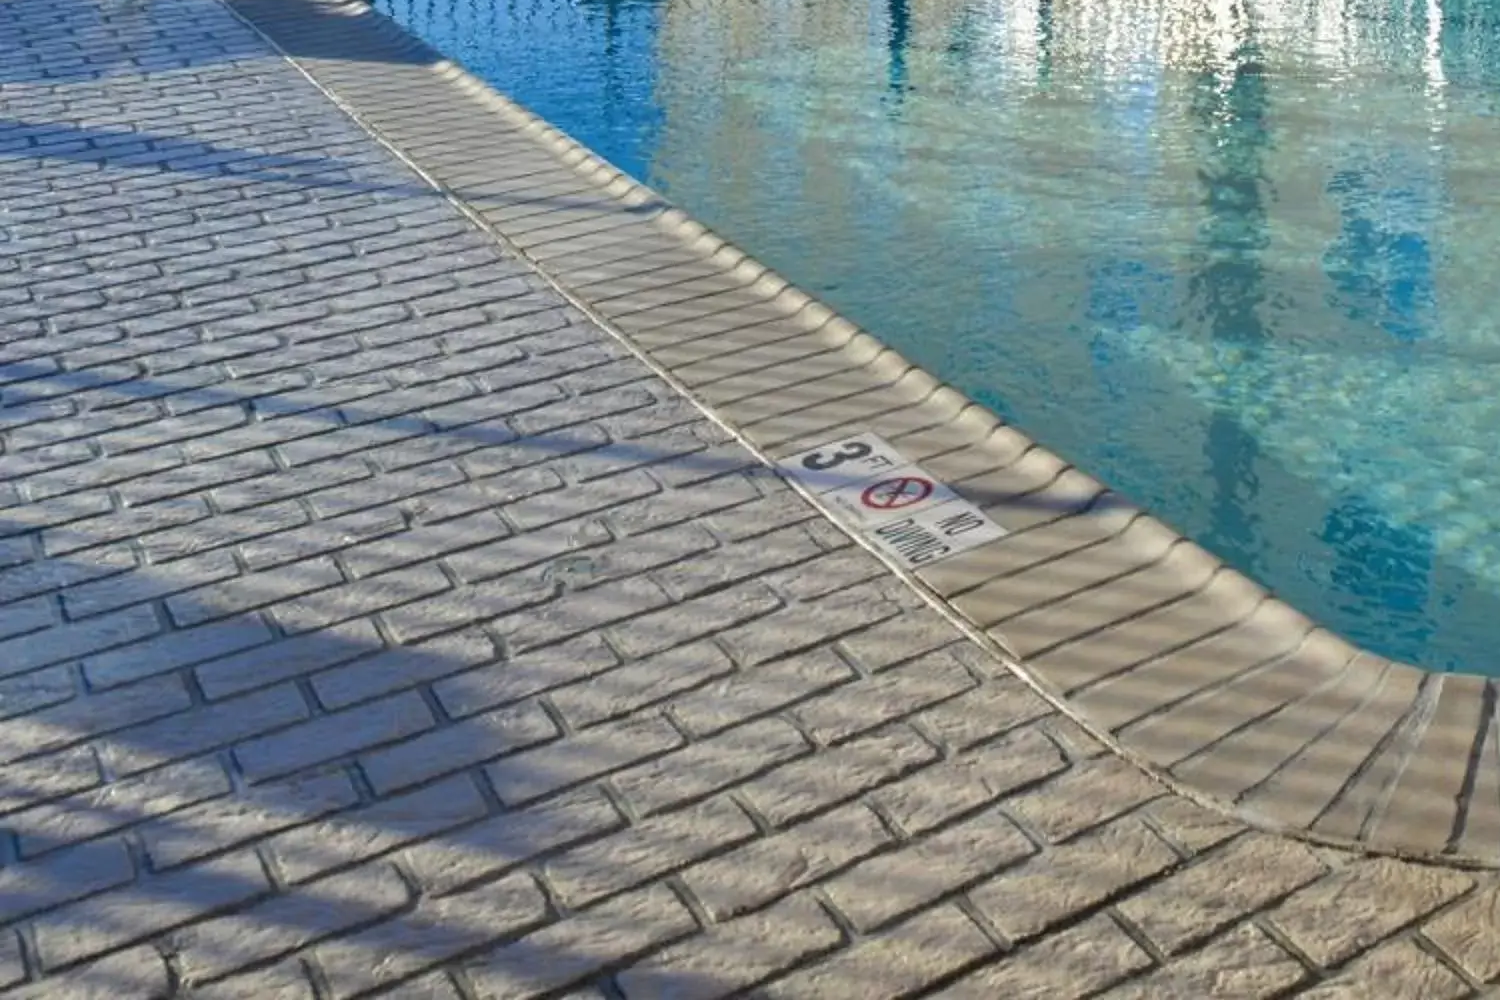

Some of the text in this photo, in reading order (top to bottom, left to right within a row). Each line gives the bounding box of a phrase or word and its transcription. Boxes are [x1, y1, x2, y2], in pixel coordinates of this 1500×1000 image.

[801, 441, 894, 471] 3 FT
[934, 511, 985, 536] NO
